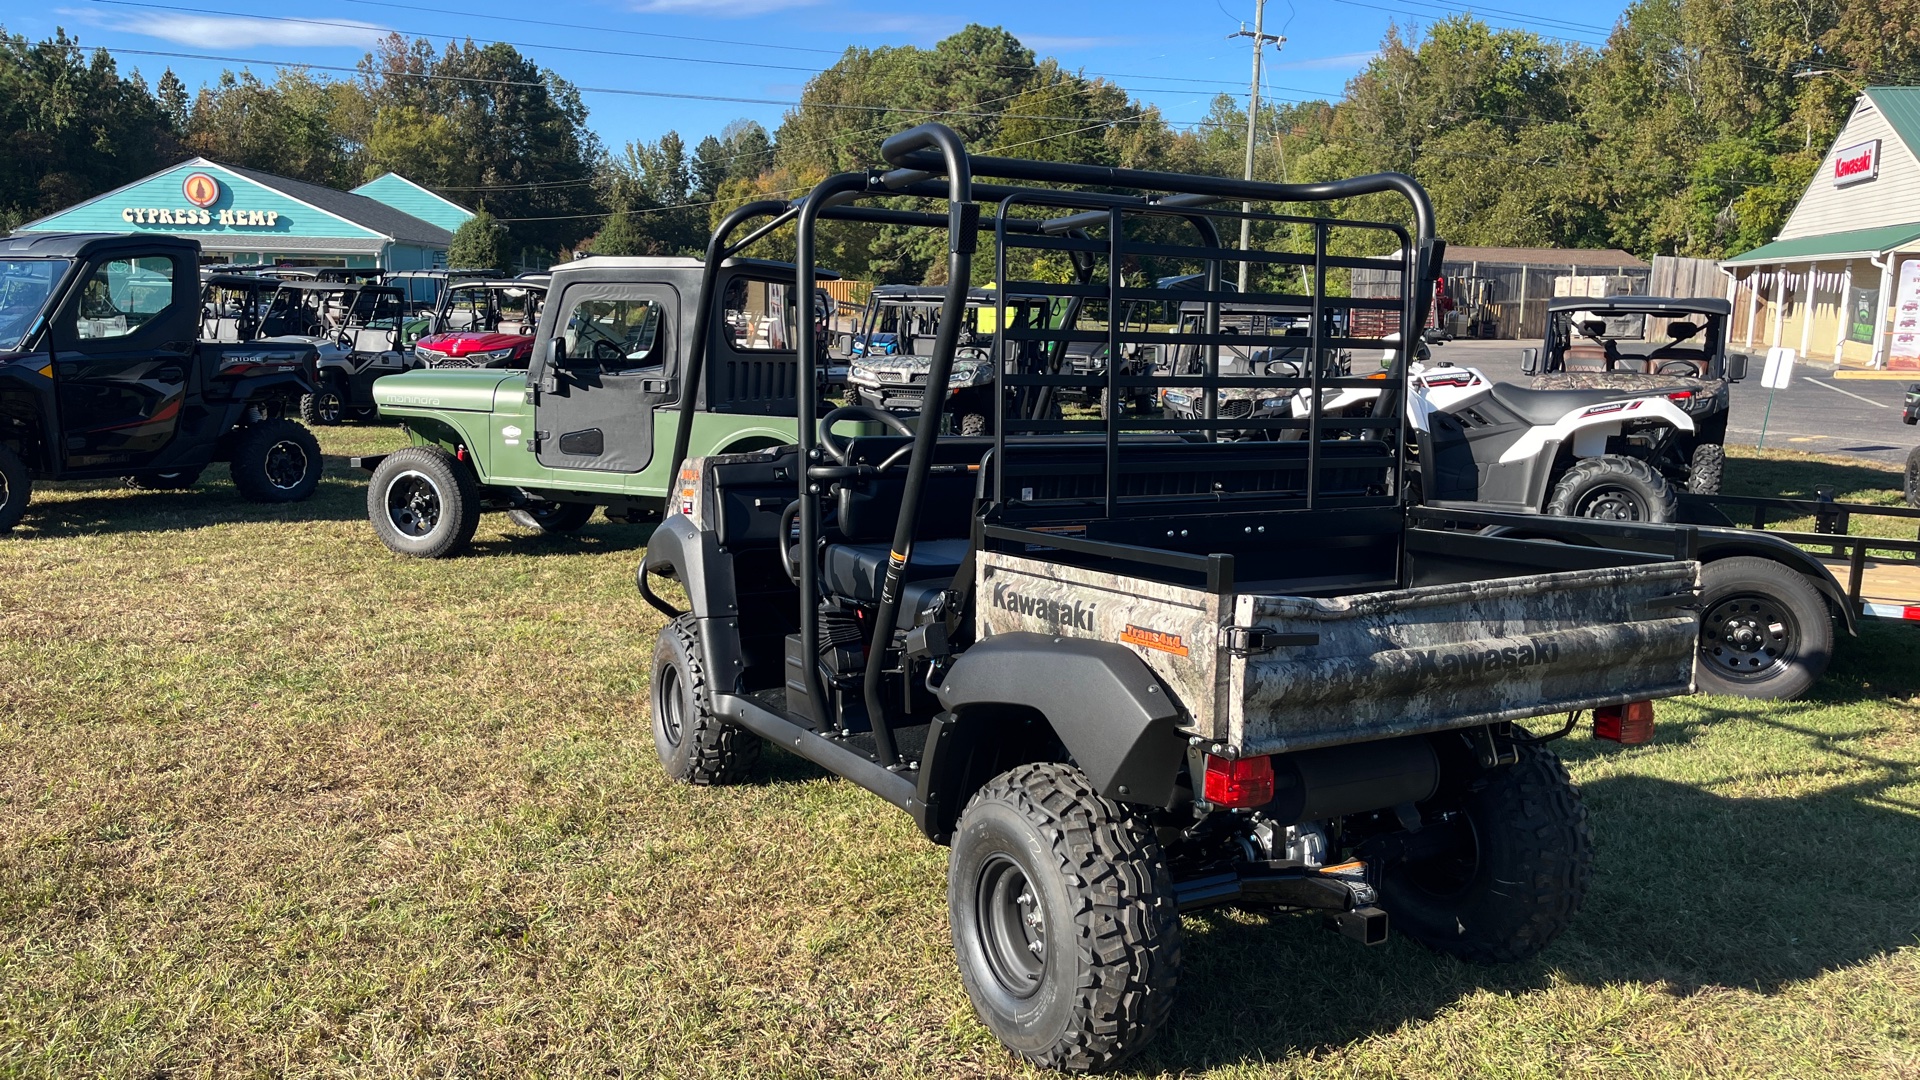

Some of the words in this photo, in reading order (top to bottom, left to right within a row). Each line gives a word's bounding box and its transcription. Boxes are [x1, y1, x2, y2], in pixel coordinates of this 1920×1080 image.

[1834, 149, 1872, 179] Kawasaki
[122, 208, 211, 225] CYPRESS
[219, 209, 279, 226] HEMP
[386, 394, 440, 406] mahindra
[1589, 403, 1621, 413] Kawasaki
[993, 581, 1097, 632] Kawasaki
[1126, 624, 1181, 648] Trans4x4
[1415, 636, 1559, 678] Kawasaki
